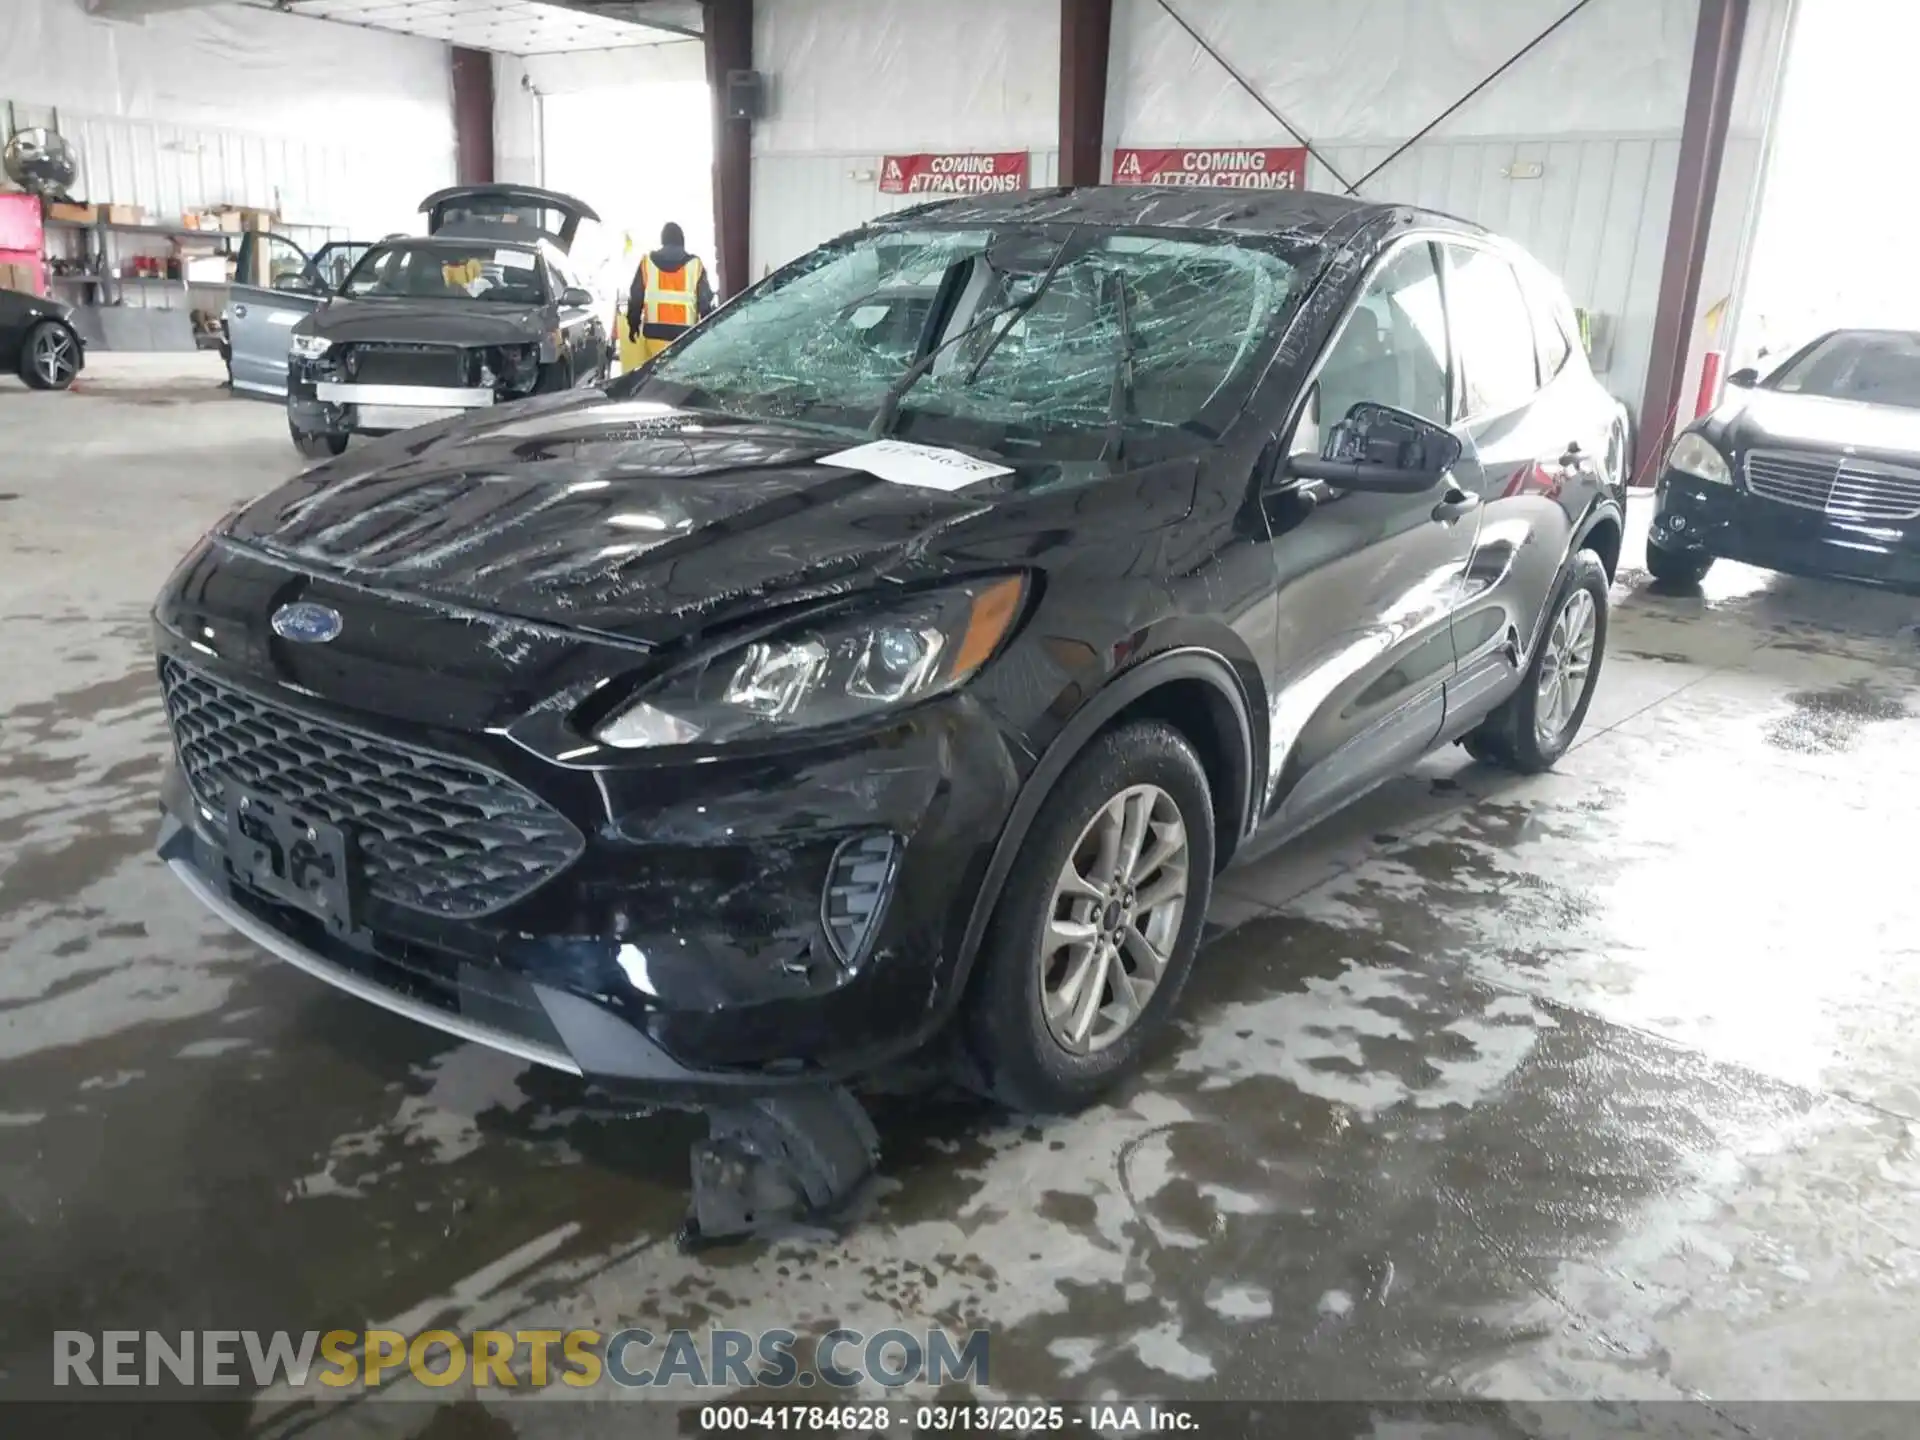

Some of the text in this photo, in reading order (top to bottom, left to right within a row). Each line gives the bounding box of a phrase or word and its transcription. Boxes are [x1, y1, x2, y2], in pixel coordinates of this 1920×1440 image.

[931, 156, 995, 173] COMING
[1183, 152, 1266, 171] COMING
[908, 173, 1021, 193] ATTRACTIONS!
[1150, 170, 1296, 190] ATTRACTIONS!
